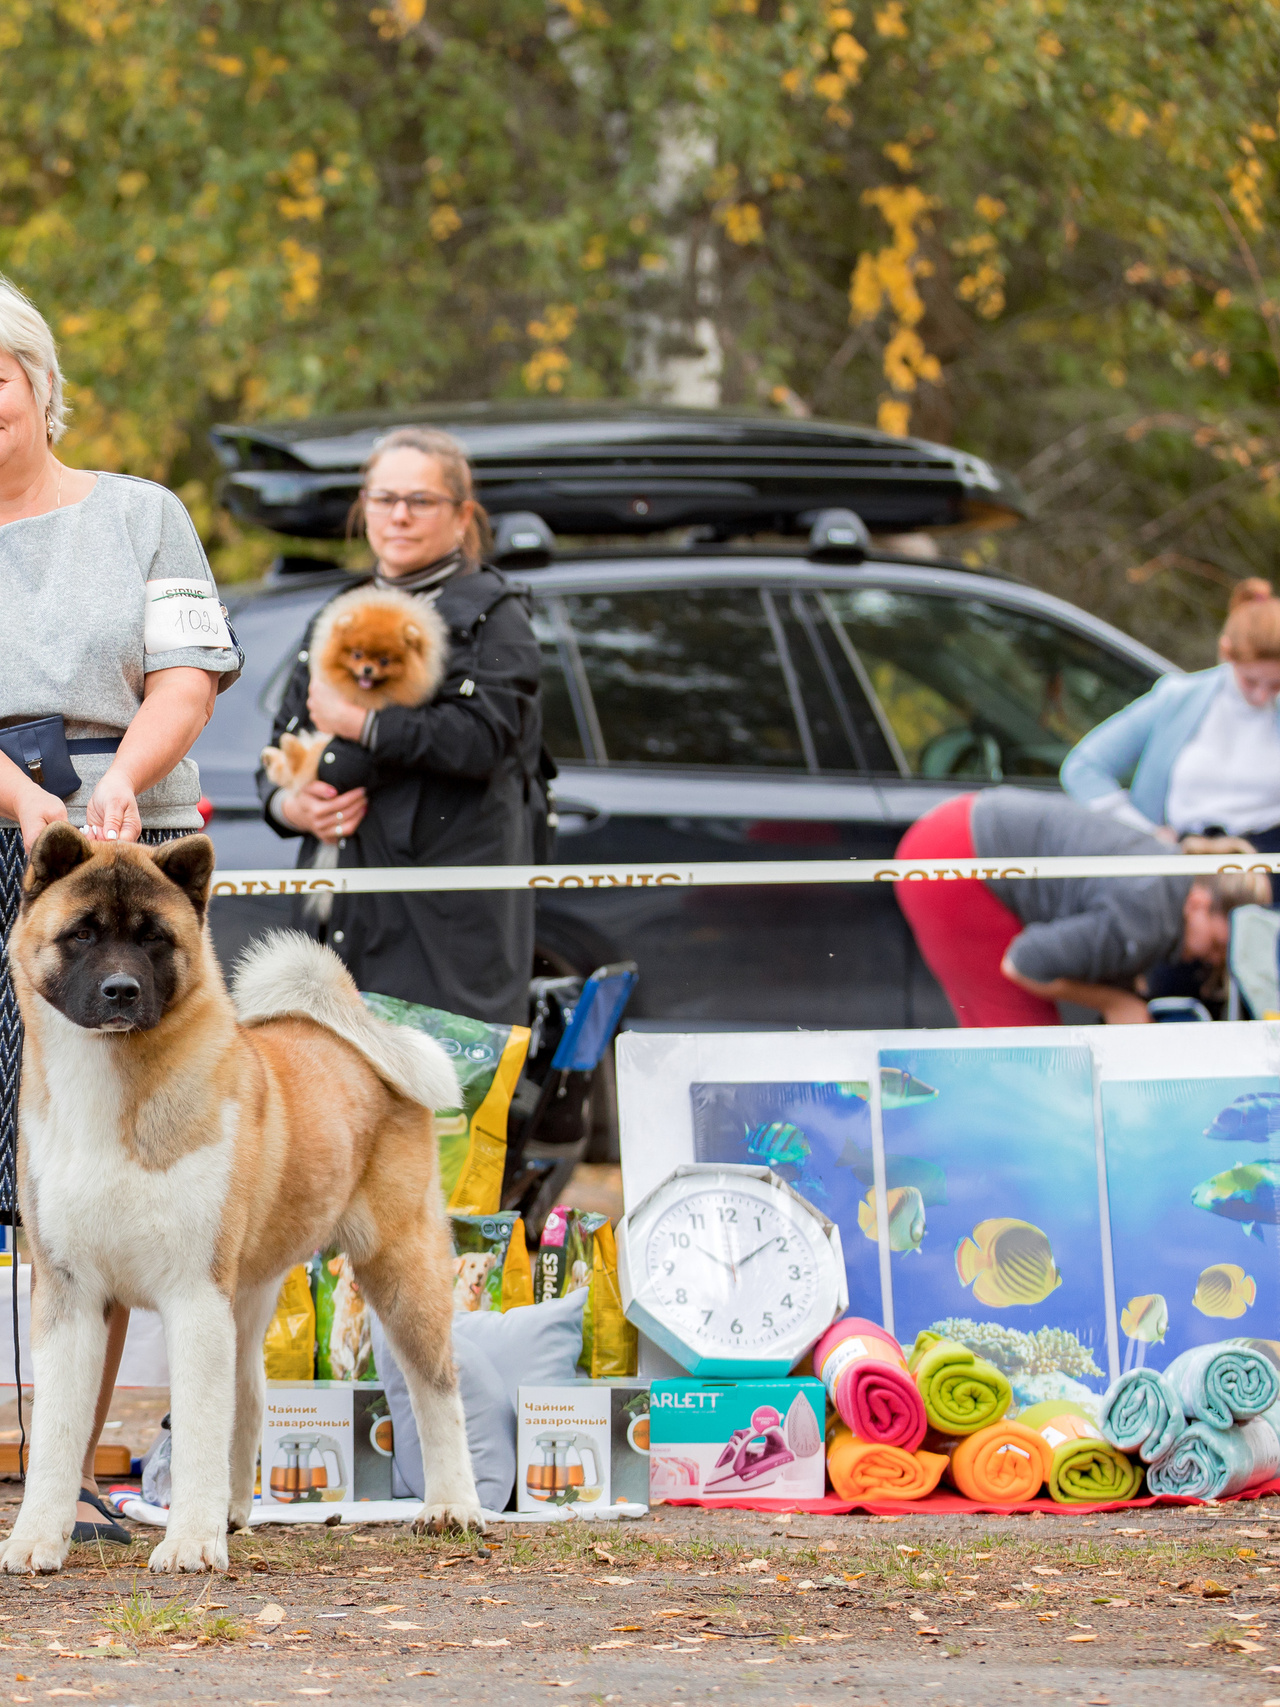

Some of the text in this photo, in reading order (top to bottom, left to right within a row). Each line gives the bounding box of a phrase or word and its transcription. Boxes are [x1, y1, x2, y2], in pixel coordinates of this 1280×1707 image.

[174, 609, 219, 635] 102
[689, 1213, 705, 1229] 11
[717, 1207, 738, 1223] 12
[754, 1216, 762, 1232] 1
[671, 1233, 690, 1248] 10
[776, 1237, 789, 1252] 2
[662, 1260, 675, 1276] 9
[788, 1265, 801, 1280] 3
[676, 1288, 688, 1304] 8
[780, 1293, 794, 1308] 4
[702, 1310, 714, 1325] 7
[762, 1312, 774, 1328] 5
[730, 1319, 743, 1334] 6
[268, 1405, 317, 1414] Чайник
[525, 1403, 575, 1412] Чайник
[268, 1418, 350, 1428] заварочный
[525, 1416, 607, 1427] заварочный
